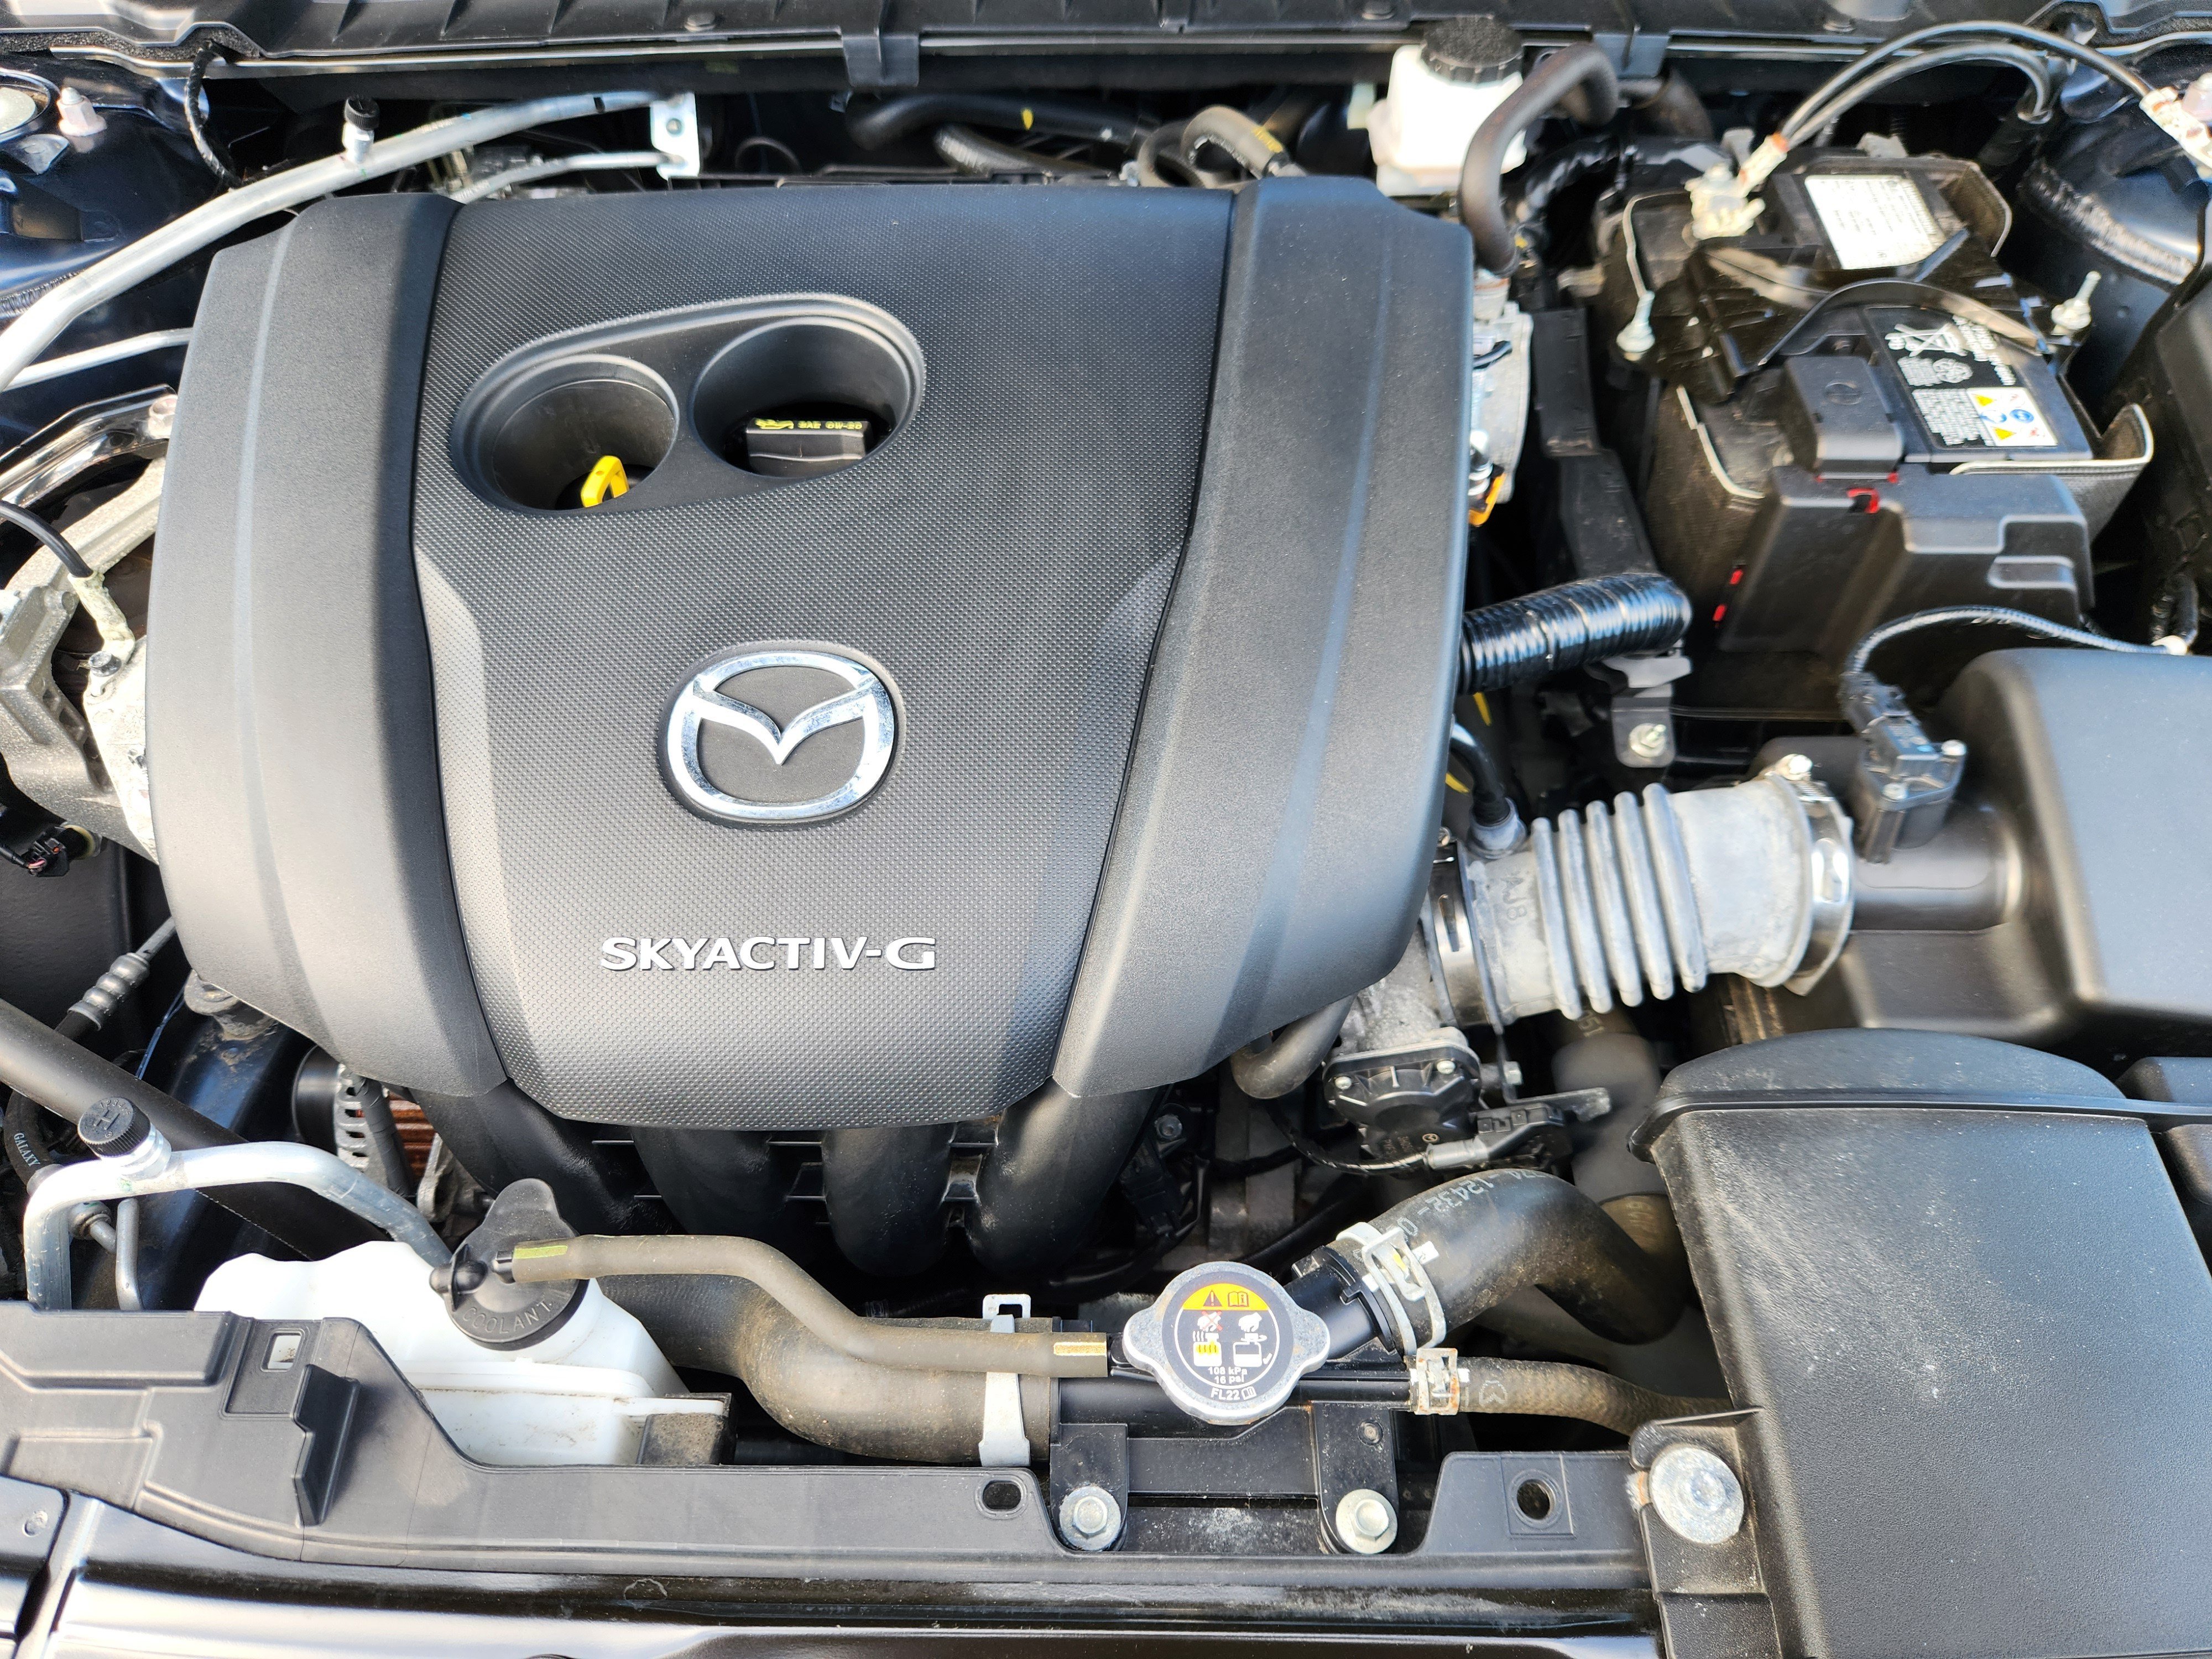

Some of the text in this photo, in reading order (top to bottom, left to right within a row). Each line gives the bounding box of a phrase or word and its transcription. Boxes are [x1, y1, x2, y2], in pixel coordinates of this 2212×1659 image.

[797, 420, 821, 429] SAE
[601, 936, 936, 971] SKYACTIV-G
[92, 1109, 120, 1130] H
[14, 1133, 41, 1167] GALAXY
[462, 1300, 551, 1334] COOLANT
[1208, 1366, 1248, 1375] 108 kPa
[1214, 1374, 1244, 1384] 16 psi
[1211, 1387, 1240, 1401] FL22
